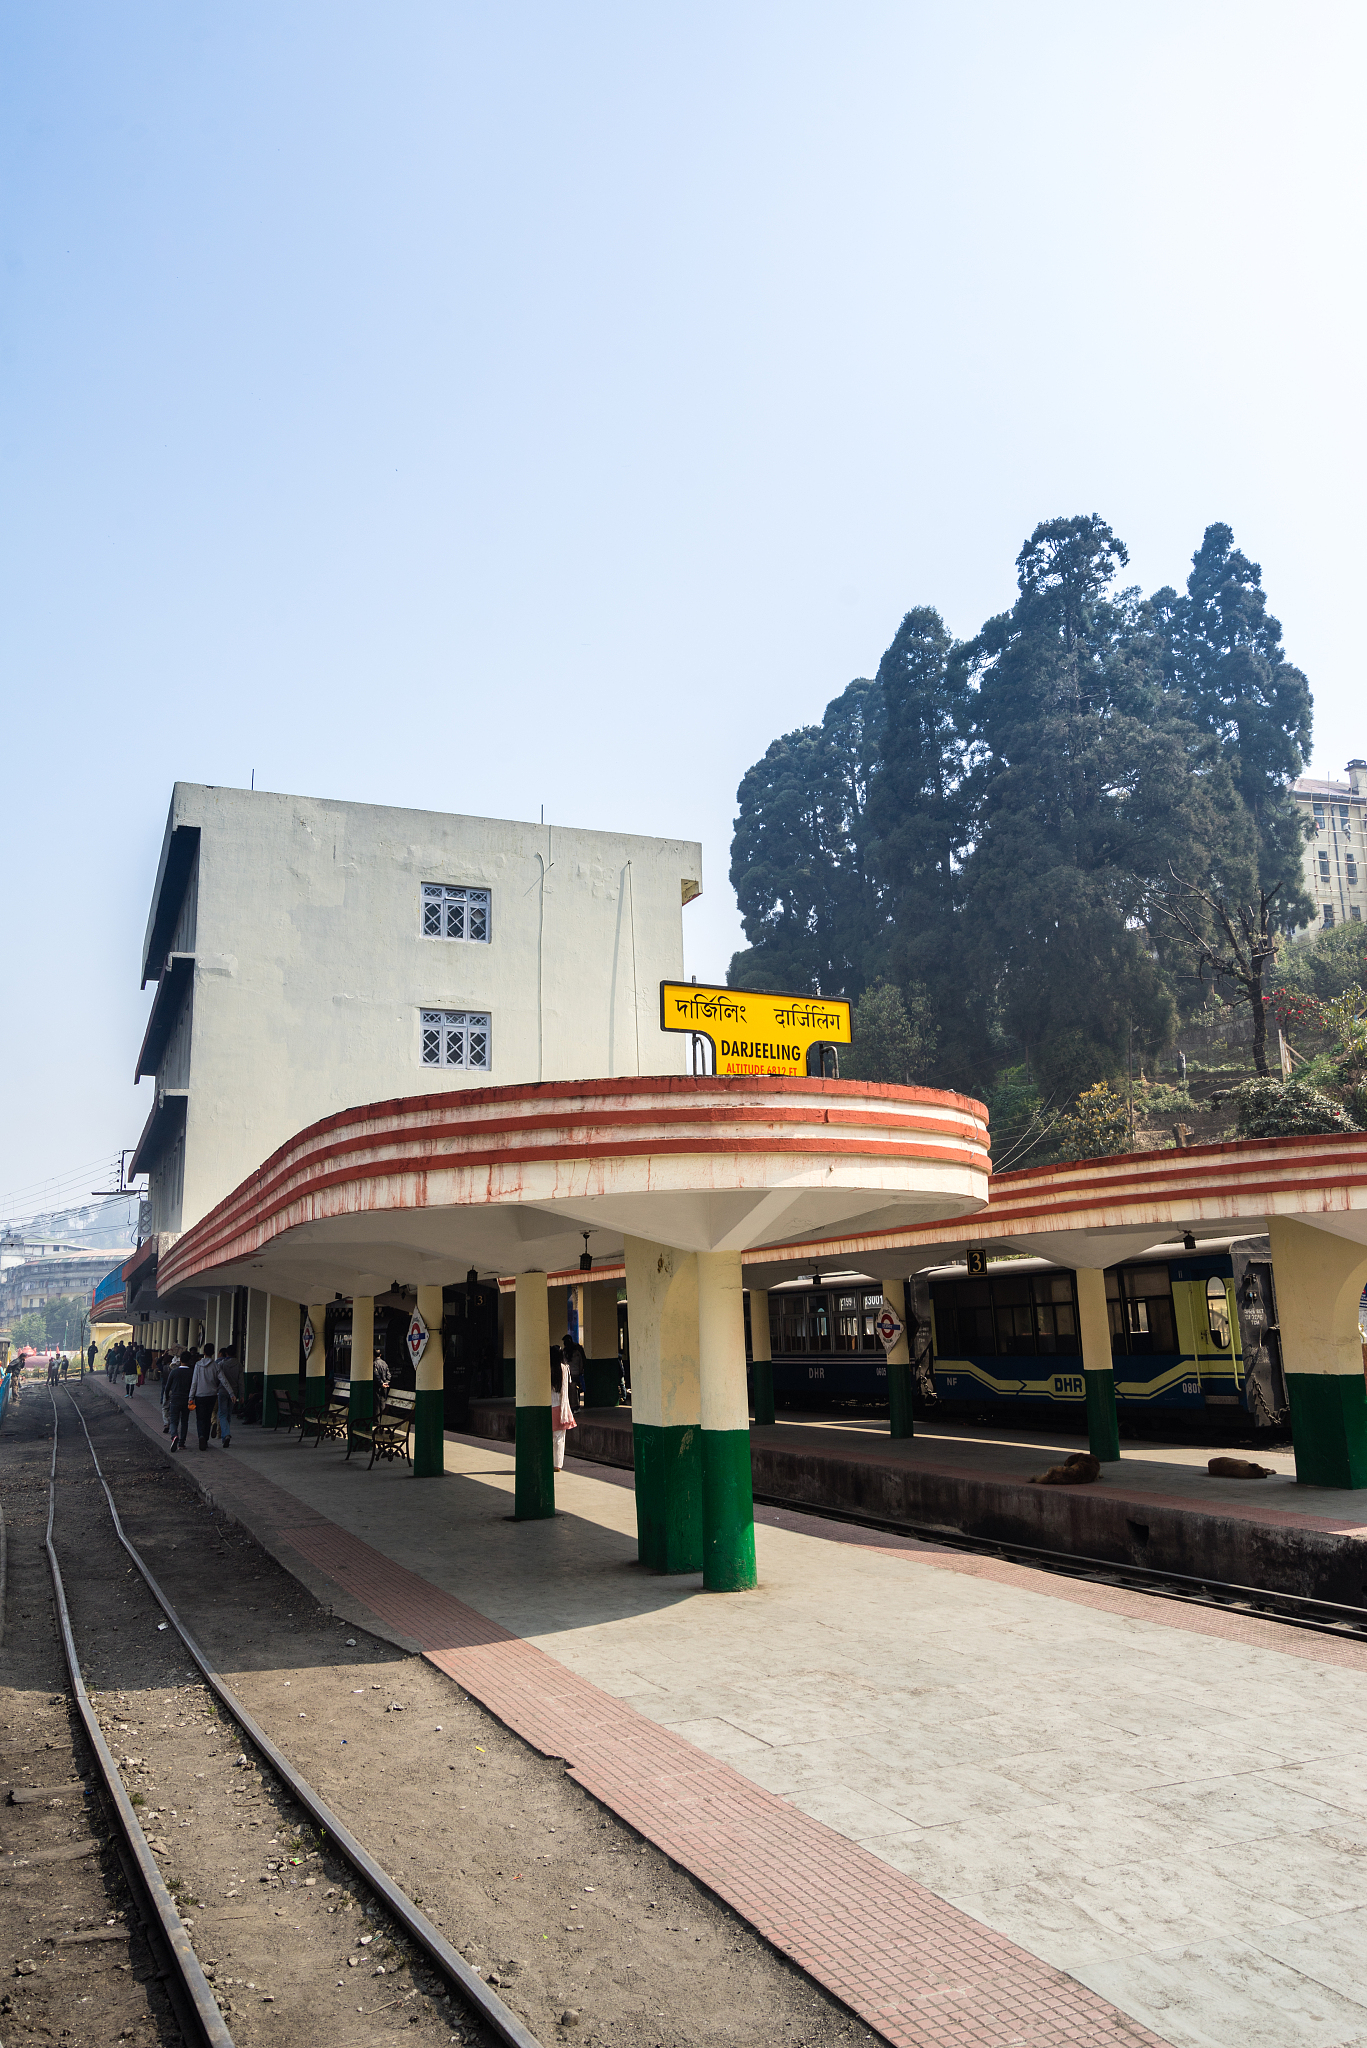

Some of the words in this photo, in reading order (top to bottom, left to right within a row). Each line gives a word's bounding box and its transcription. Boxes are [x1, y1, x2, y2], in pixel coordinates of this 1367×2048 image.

[674, 993, 747, 1024] দার্জিলিং
[773, 1003, 841, 1030] दार्जिलिंग
[721, 1039, 801, 1061] DARJEELING
[726, 1062, 765, 1075] ALTITUDE
[788, 1067, 798, 1076] FT
[972, 1252, 982, 1272] 3
[476, 1295, 485, 1305] 3
[808, 1367, 825, 1379] DHR
[946, 1377, 958, 1386] NF
[1054, 1377, 1083, 1393] DHR
